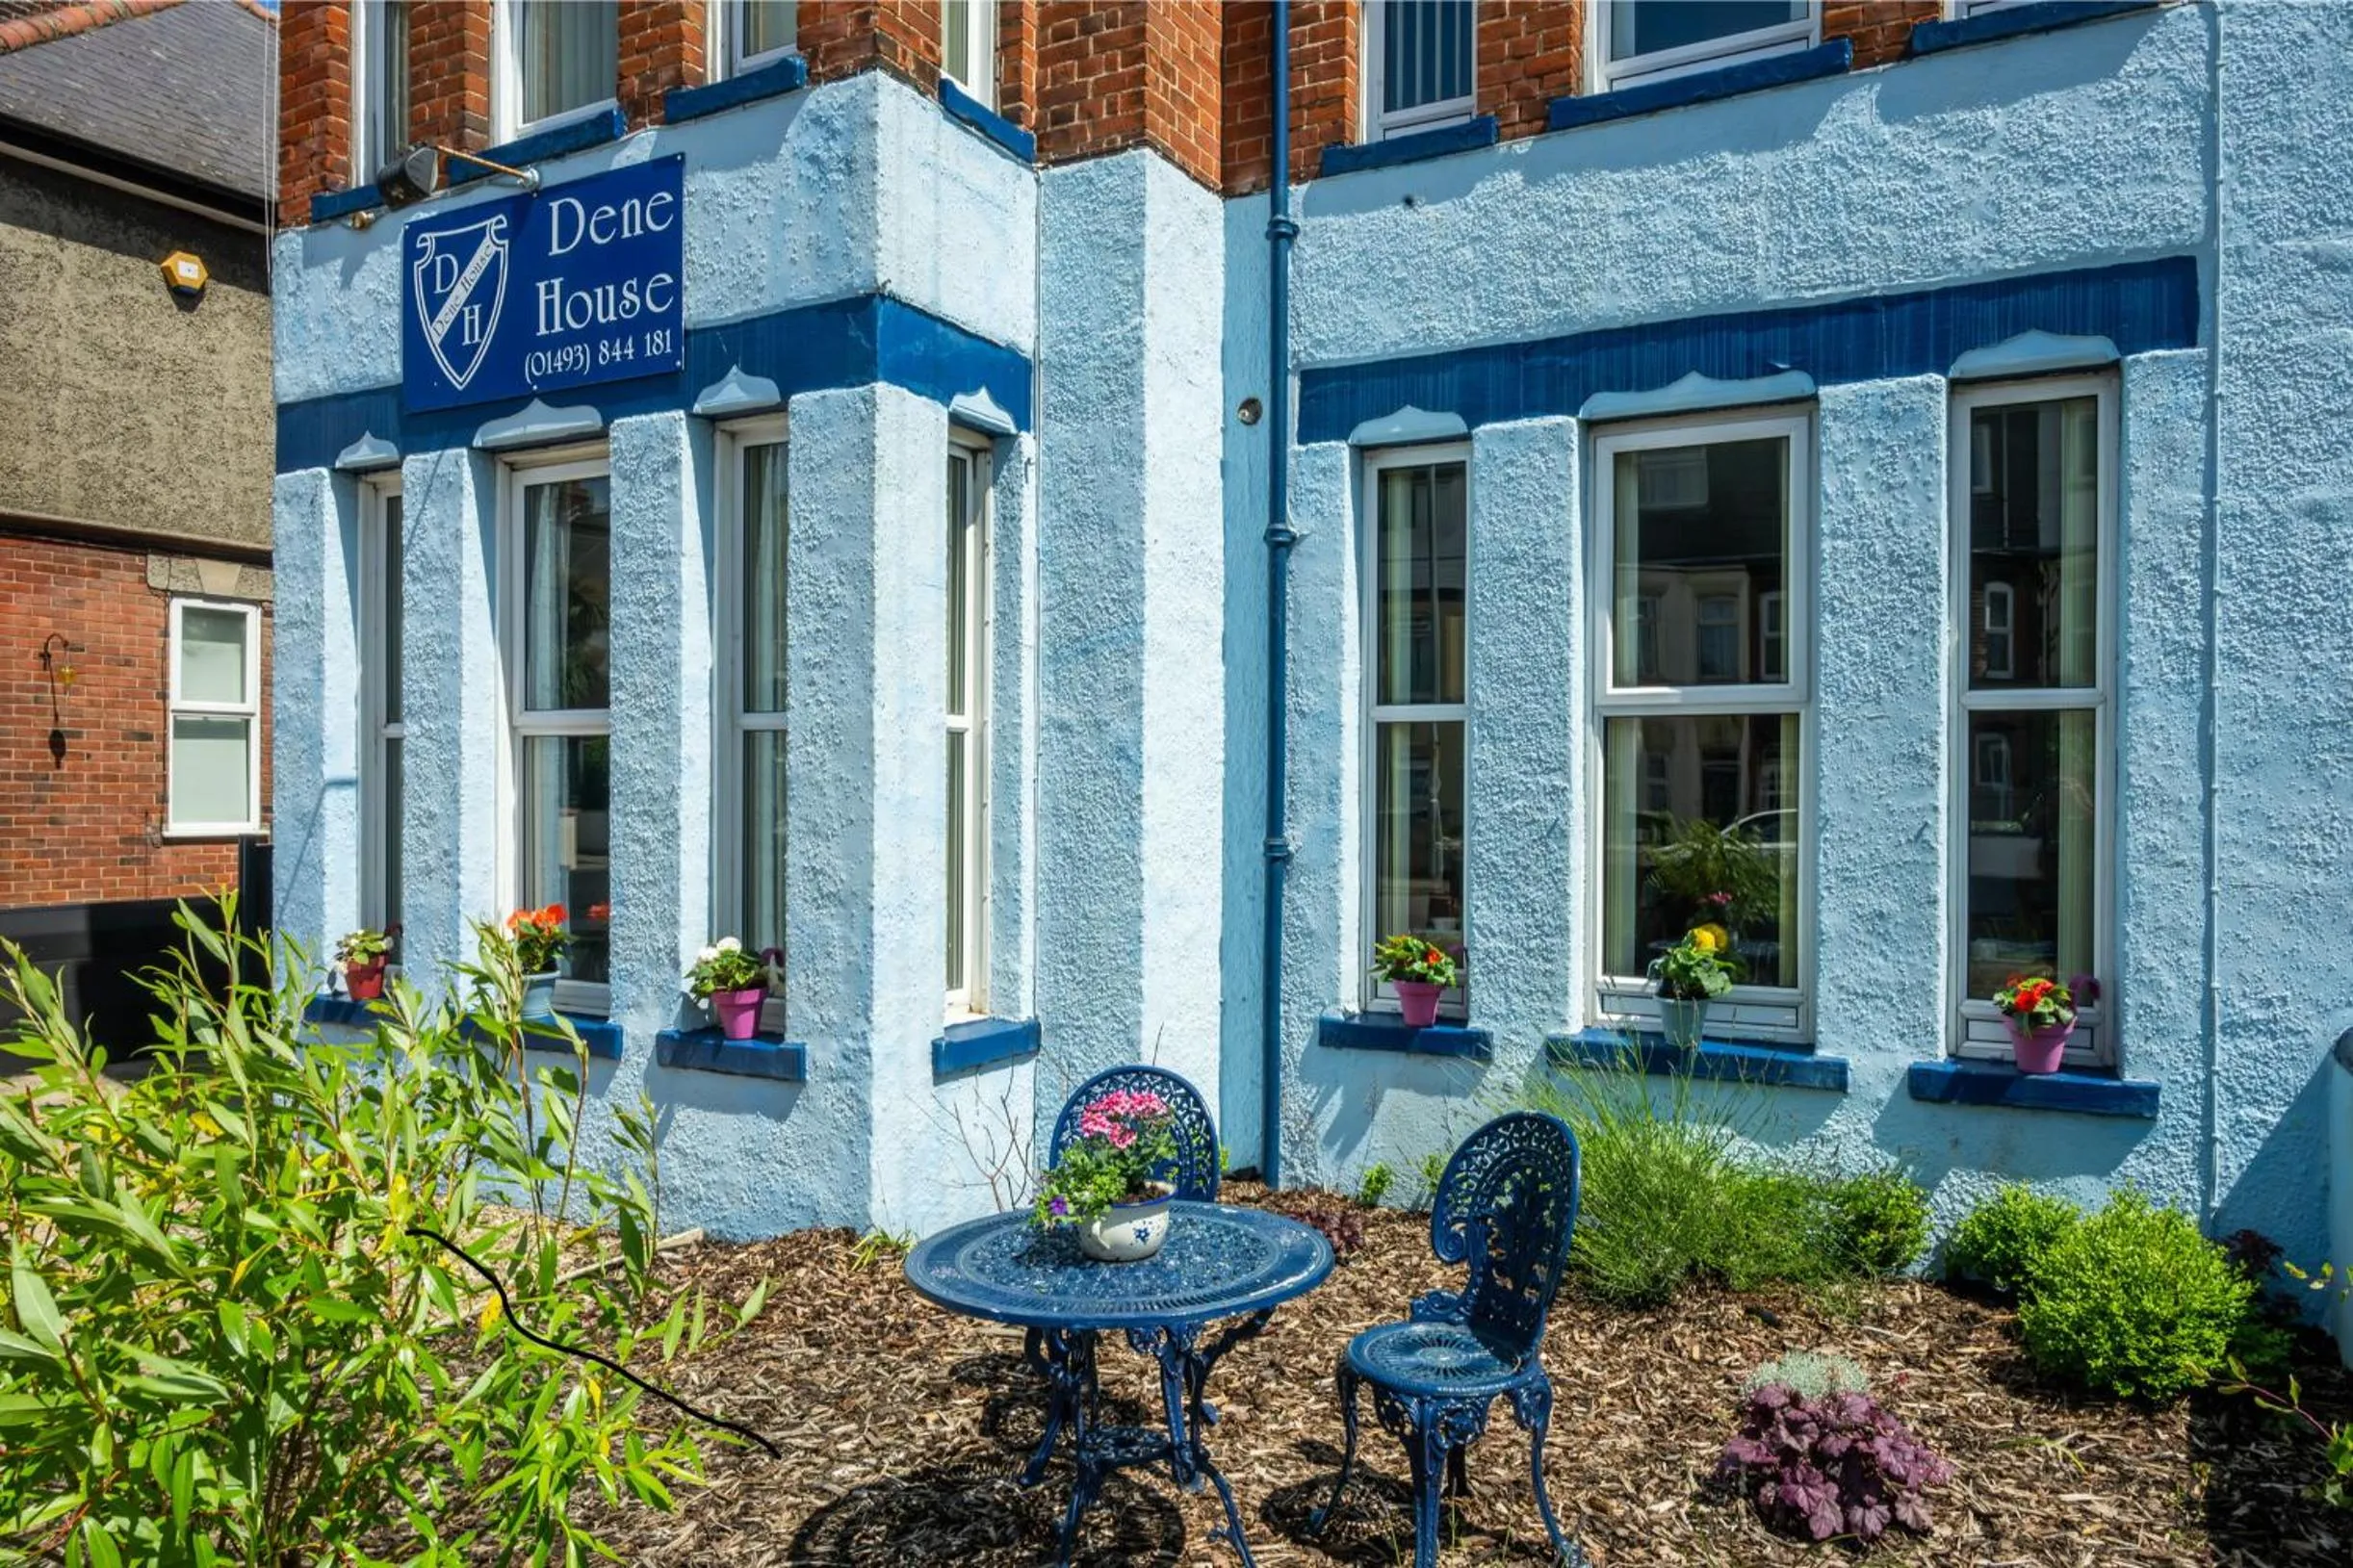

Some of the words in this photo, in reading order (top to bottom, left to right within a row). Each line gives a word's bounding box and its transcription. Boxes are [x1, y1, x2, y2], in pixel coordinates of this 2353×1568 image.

[548, 192, 674, 256] Dene
[432, 295, 462, 337] Dene
[460, 244, 492, 293] House
[433, 253, 458, 294] D
[462, 304, 481, 346] H
[535, 272, 674, 337] House
[525, 344, 591, 384] (01493)
[598, 338, 634, 365] 844
[644, 329, 672, 356] 181
